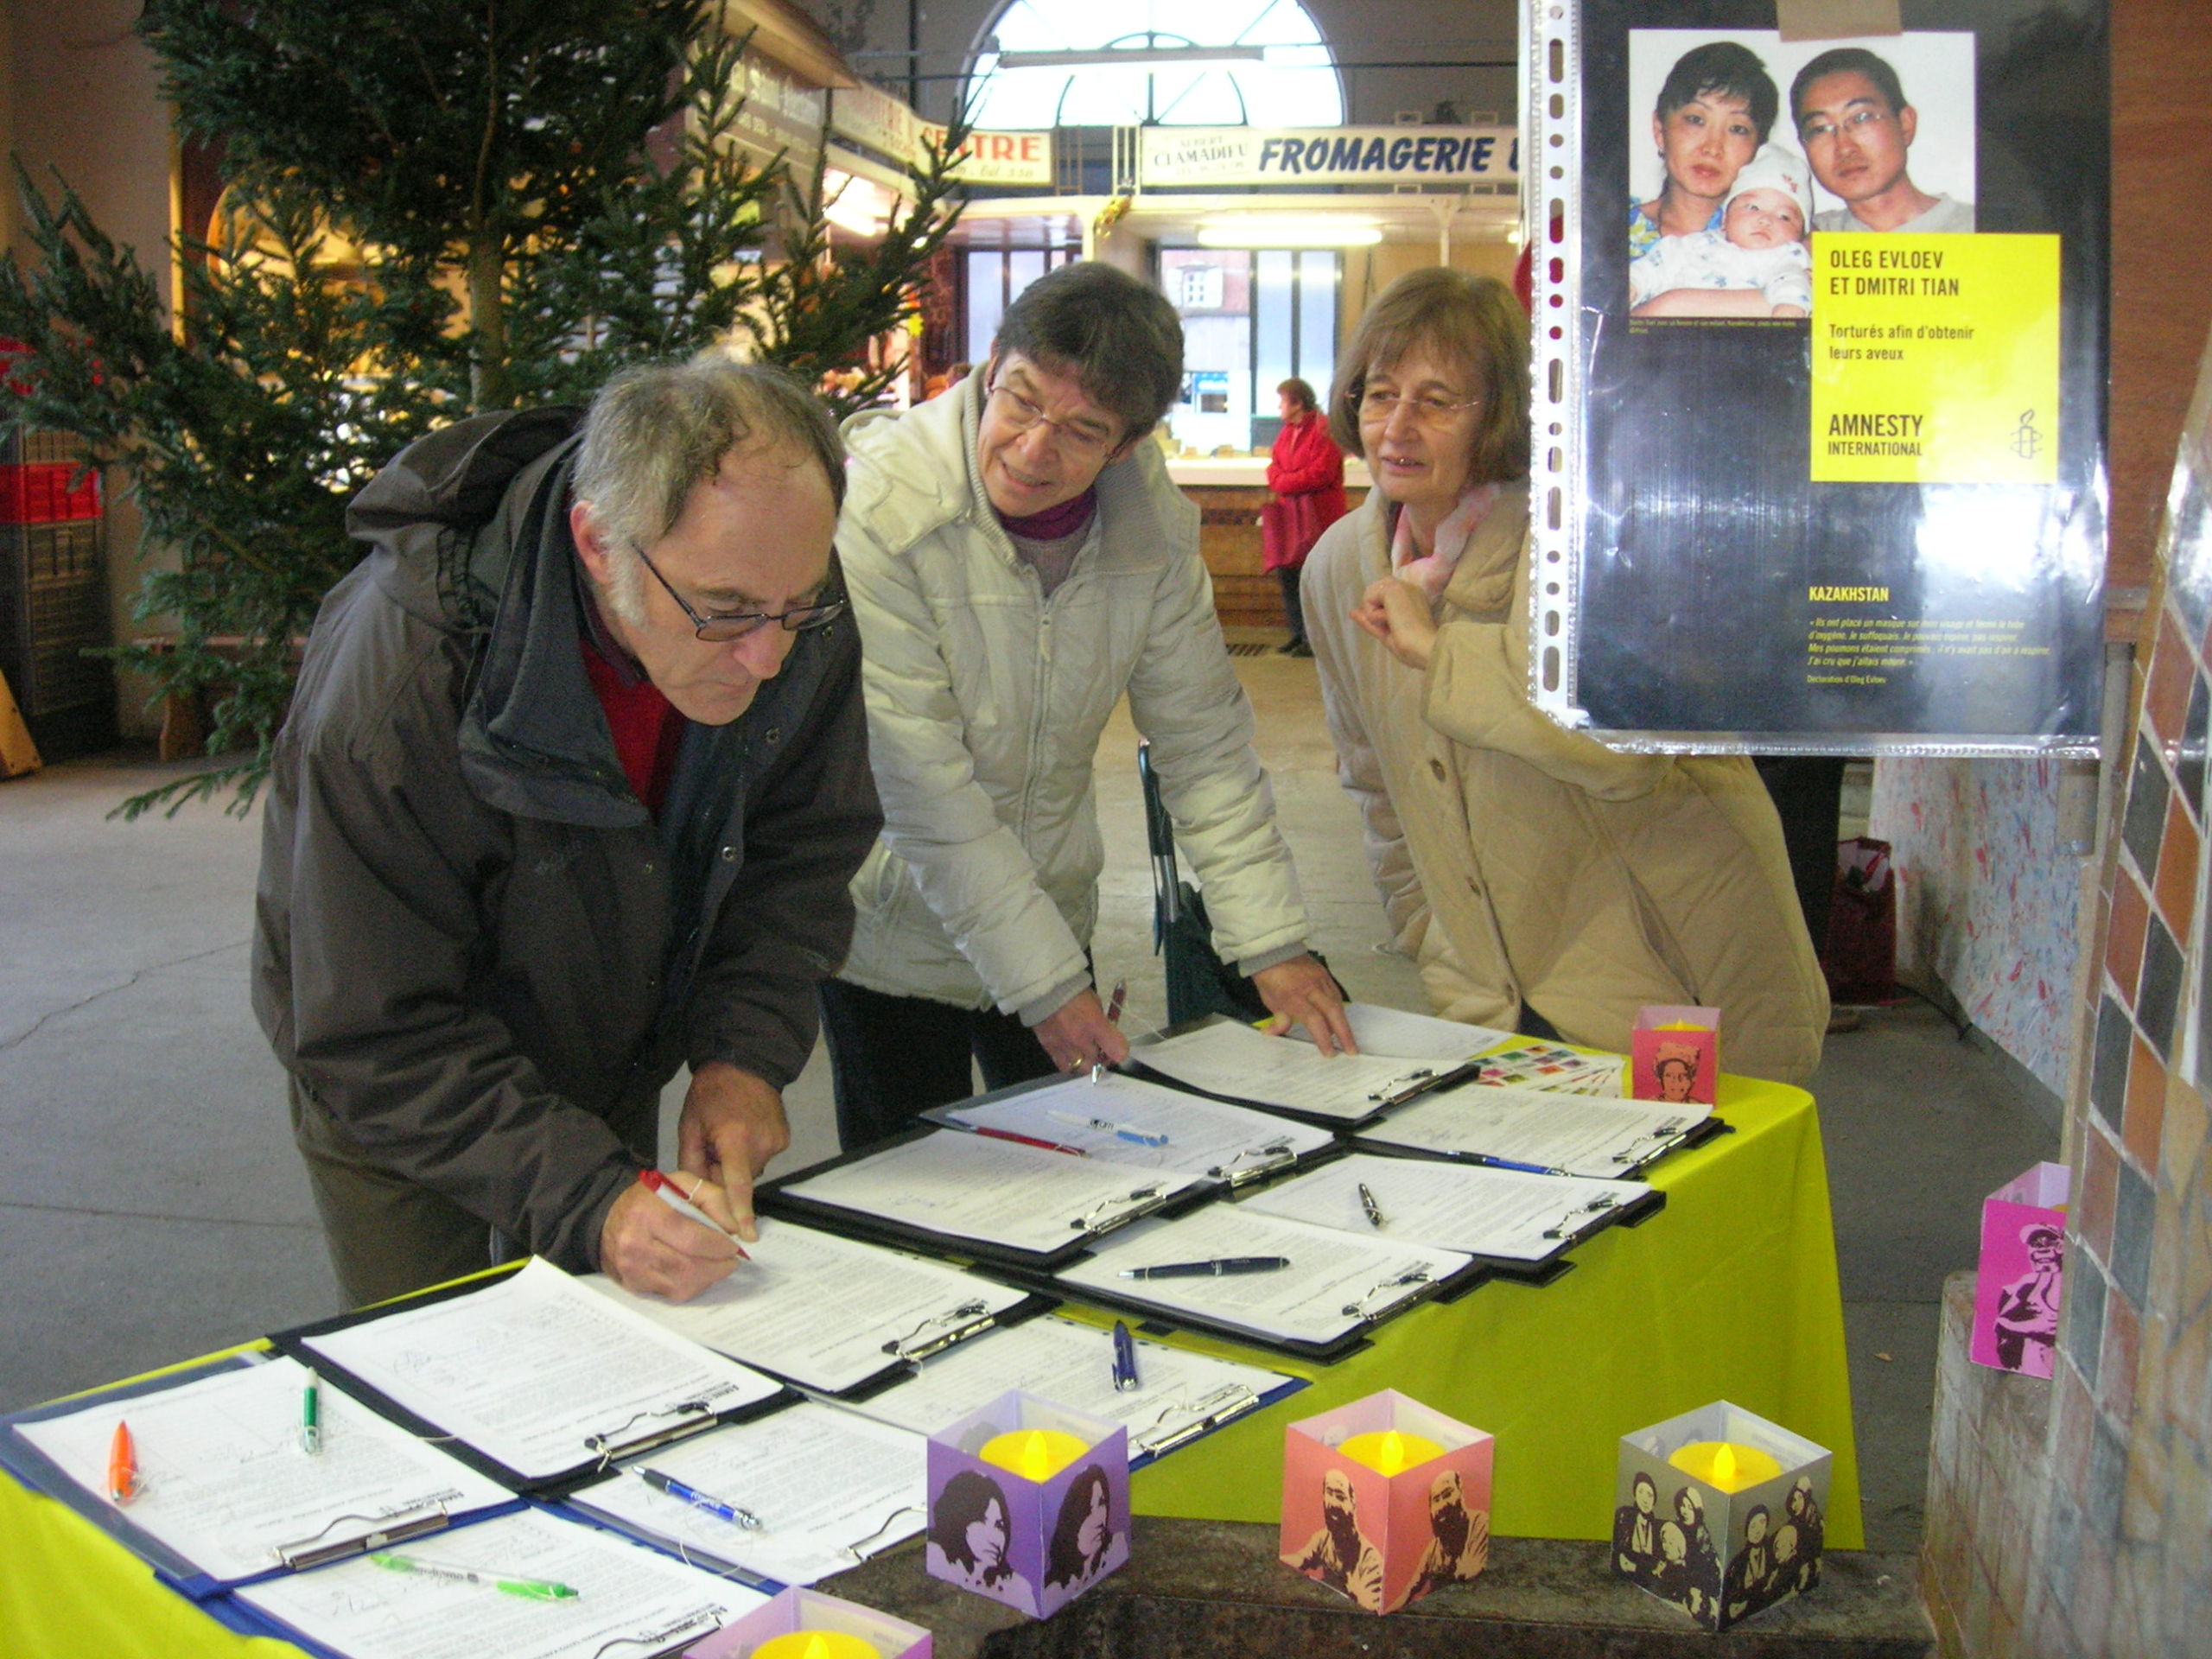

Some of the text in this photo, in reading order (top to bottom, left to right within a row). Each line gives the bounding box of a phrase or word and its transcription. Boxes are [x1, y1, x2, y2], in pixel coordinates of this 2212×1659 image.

[1258, 136, 1496, 174] FROMAGERIE
[1830, 251, 1943, 270] OLEG EVLOEV
[1830, 277, 1960, 296] ET DMITRI TIAN
[1829, 323, 1974, 340] Torturés afin d'obtenir
[1829, 346, 1904, 360] leurs aveux
[1828, 414, 1923, 437] AMNESTY
[1827, 441, 1923, 457] INTERNATIONAL
[1808, 587, 1890, 602] KAZAKHSTAN
